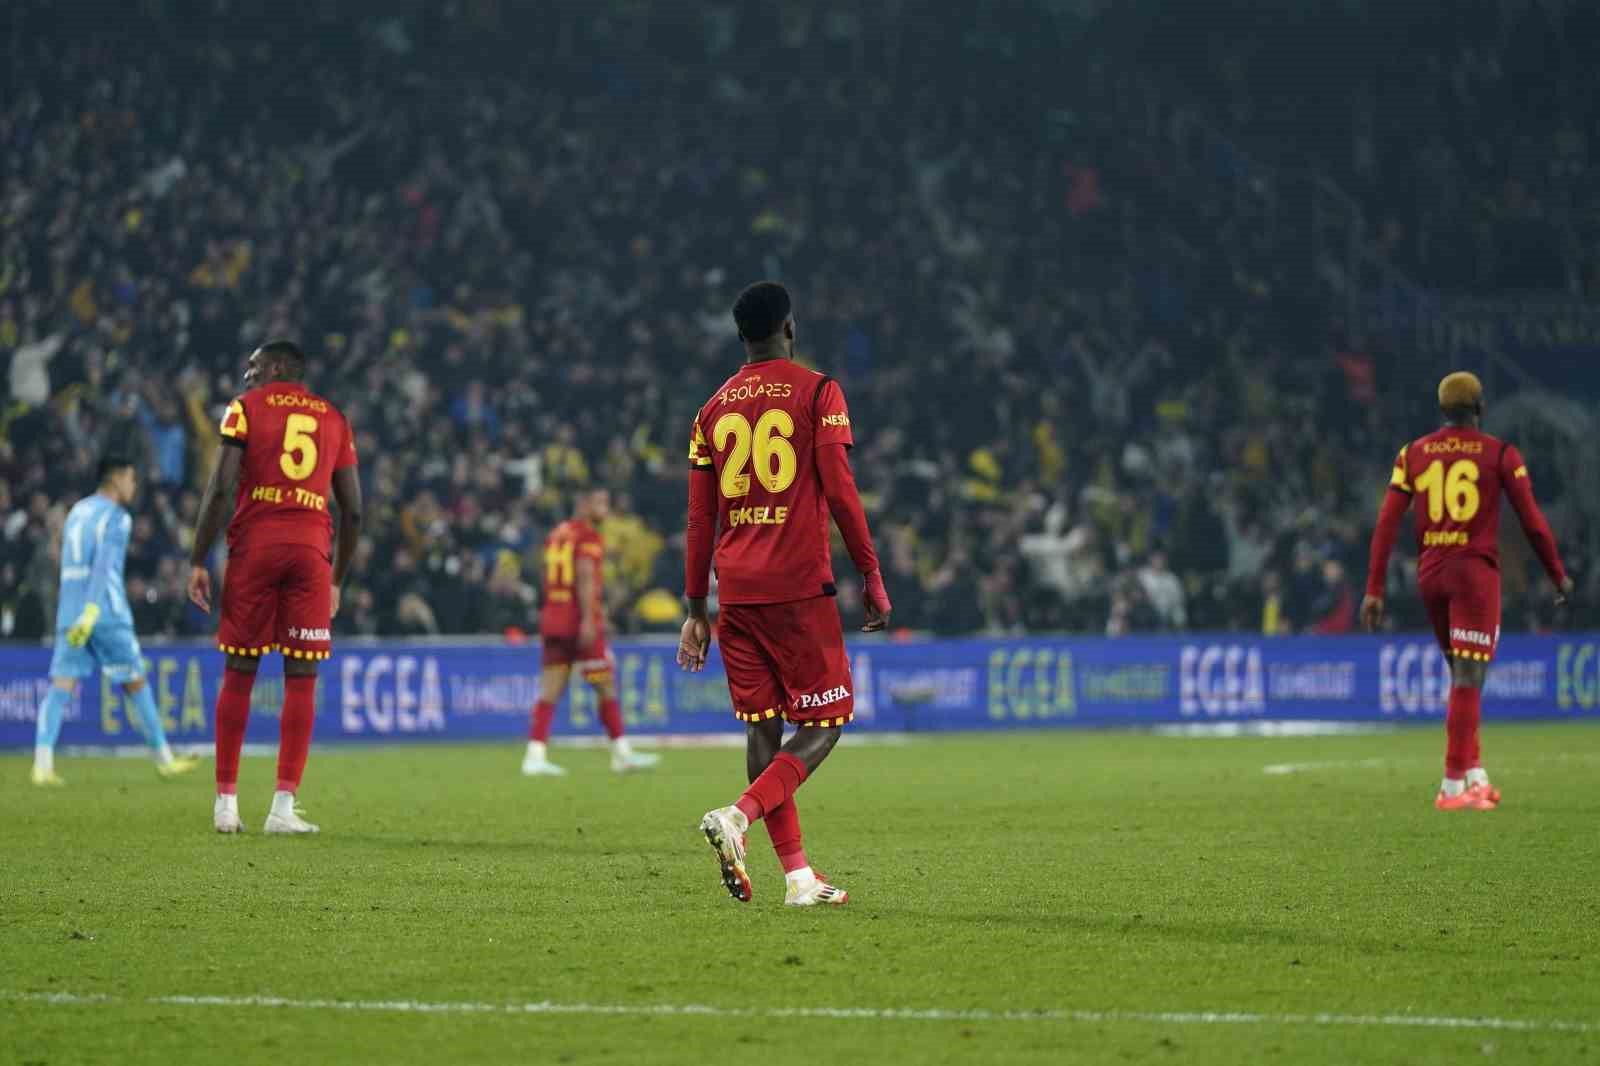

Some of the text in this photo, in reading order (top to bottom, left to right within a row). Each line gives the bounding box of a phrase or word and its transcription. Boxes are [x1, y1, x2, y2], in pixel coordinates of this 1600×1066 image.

[280, 413, 318, 480] 5
[713, 409, 797, 498] 26
[1414, 459, 1480, 523] 16
[340, 655, 444, 733] EGEA
[800, 685, 851, 709] PASHA
[988, 649, 1078, 720] EGEA
[1179, 645, 1265, 715] EGEA
